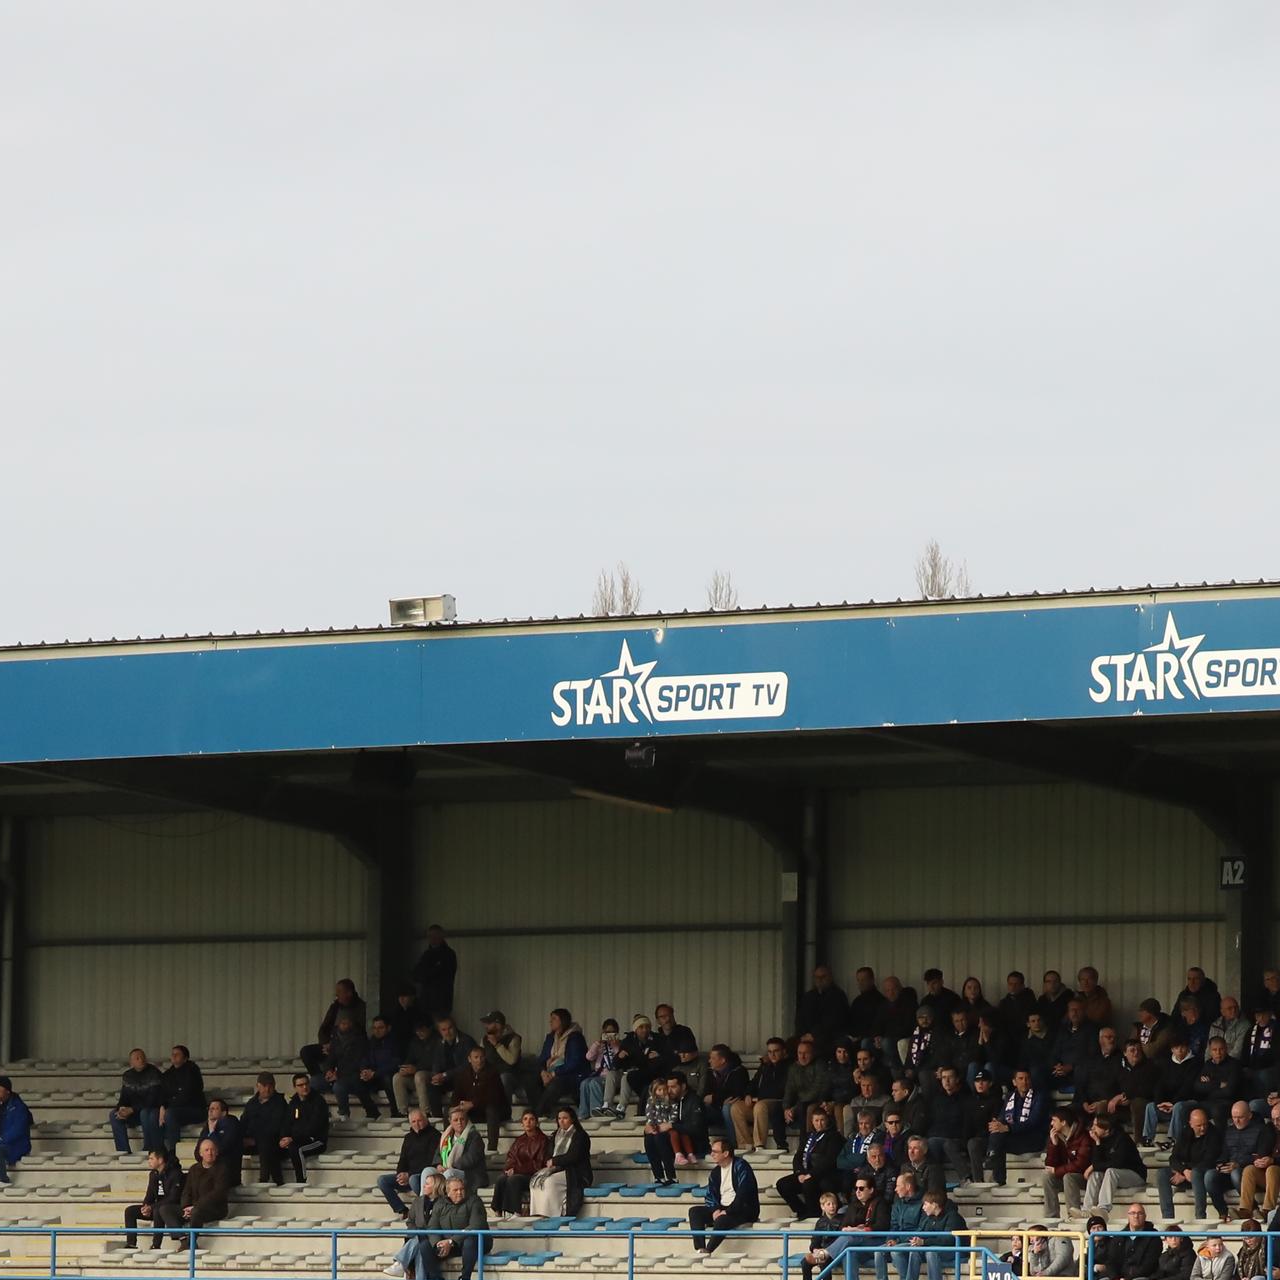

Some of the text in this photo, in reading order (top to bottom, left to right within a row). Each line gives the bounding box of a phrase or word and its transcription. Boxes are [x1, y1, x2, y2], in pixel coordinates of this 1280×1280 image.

[1088, 652, 1185, 703] STAR
[551, 678, 780, 727] STAR SPORT TV
[1221, 860, 1245, 885] A2
